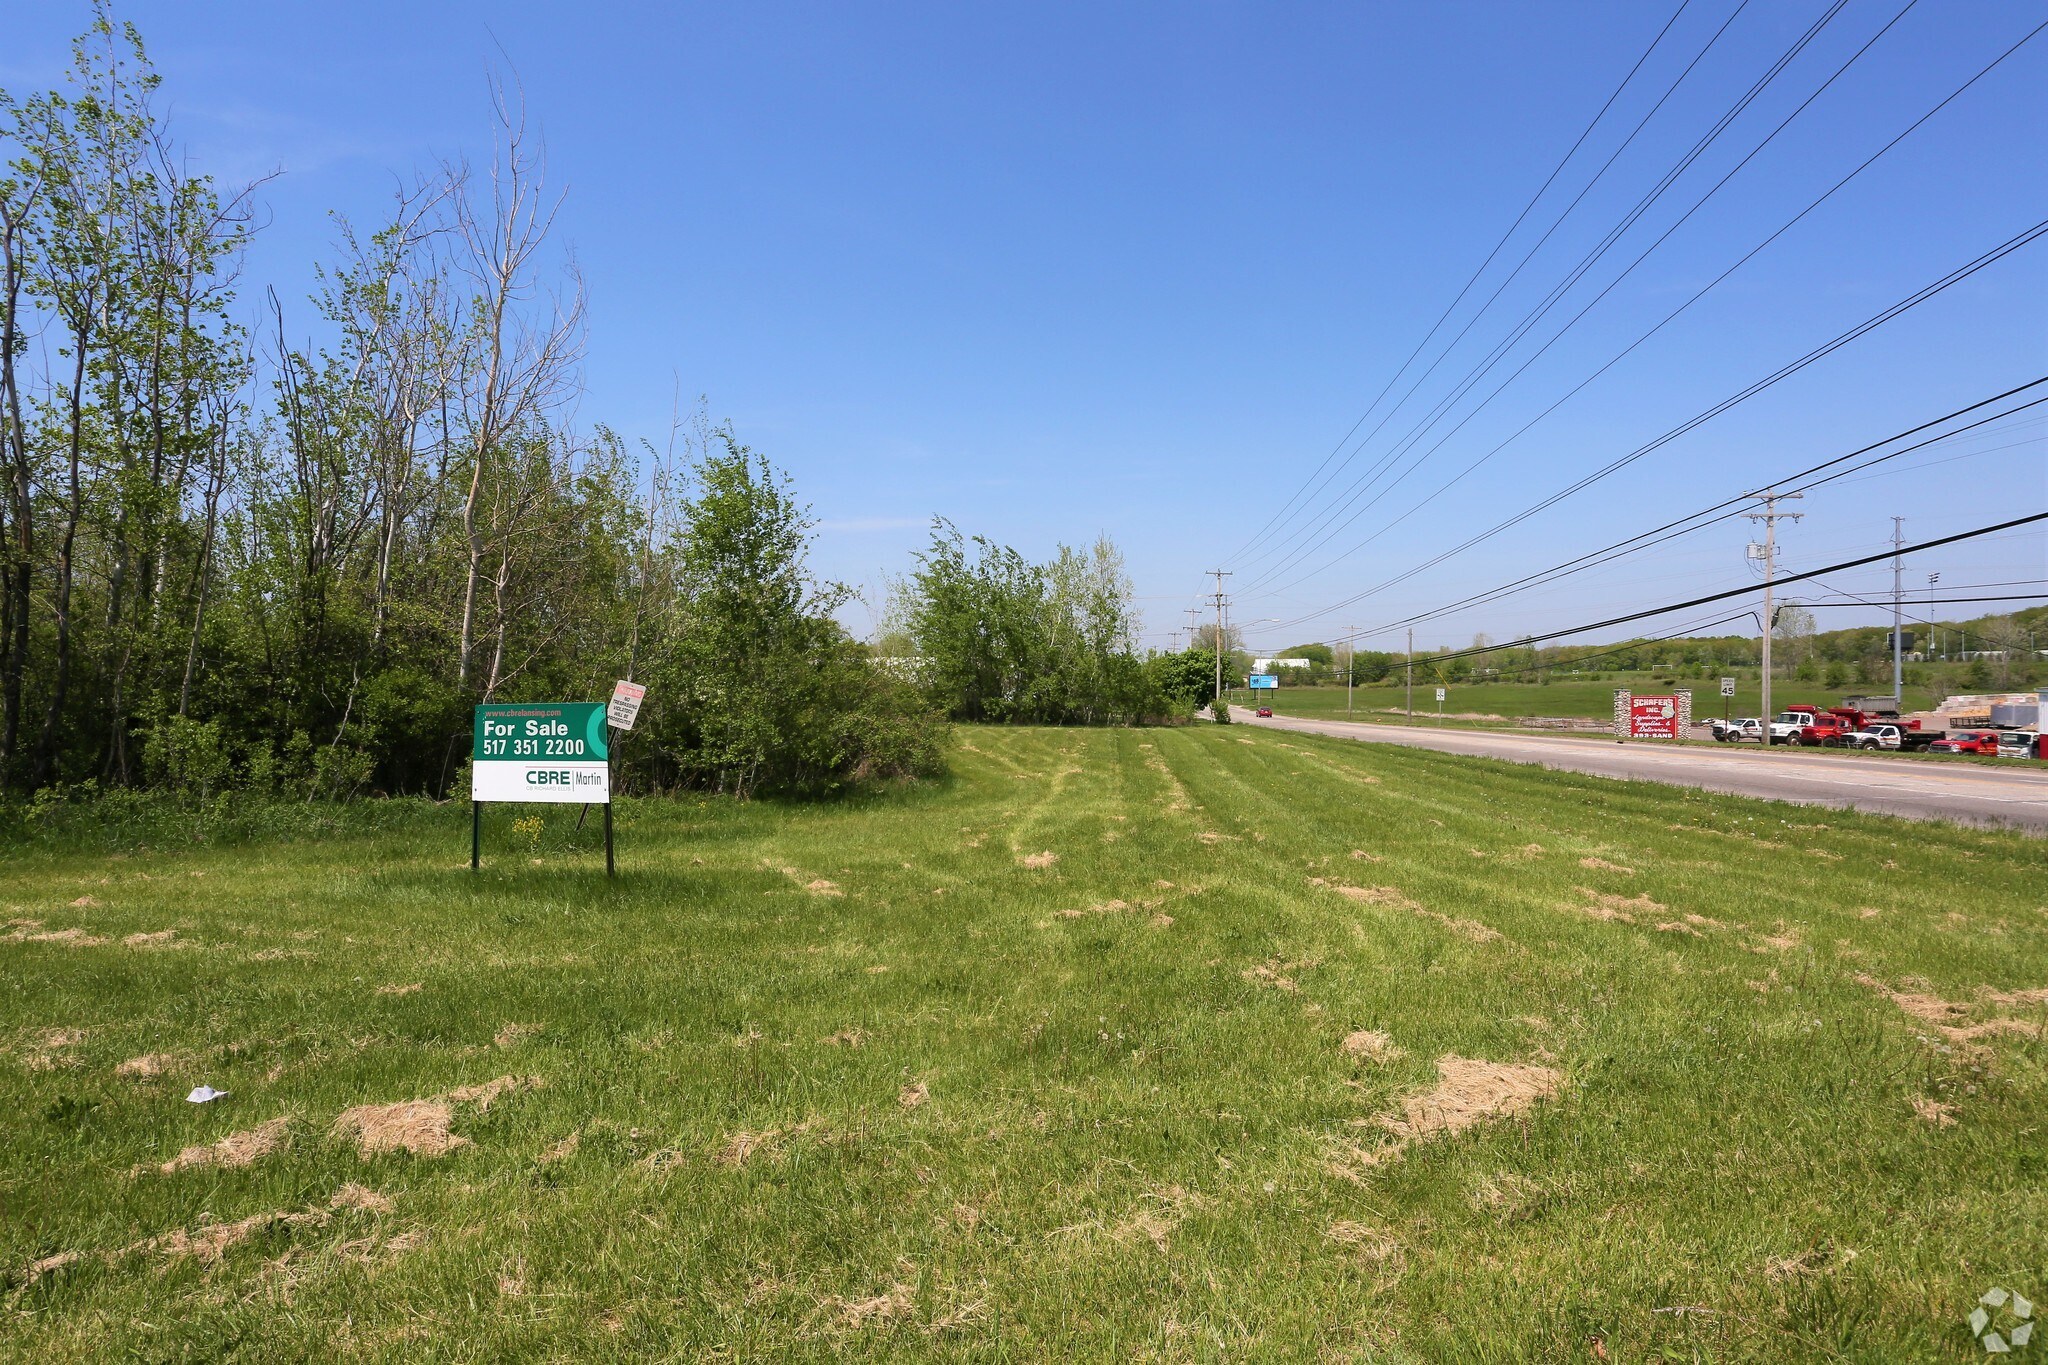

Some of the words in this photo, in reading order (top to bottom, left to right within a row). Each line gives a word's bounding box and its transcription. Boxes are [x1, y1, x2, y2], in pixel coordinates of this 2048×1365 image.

[1633, 698, 1674, 707] SCHAFER'S
[485, 709, 562, 718] www.cbrelansing.com
[484, 720, 516, 737] For
[525, 719, 569, 736] Sale
[483, 739, 507, 755] 517
[513, 739, 538, 755] 351
[545, 739, 585, 755] 2200
[525, 770, 571, 785] CBRE
[575, 770, 602, 786] Martin
